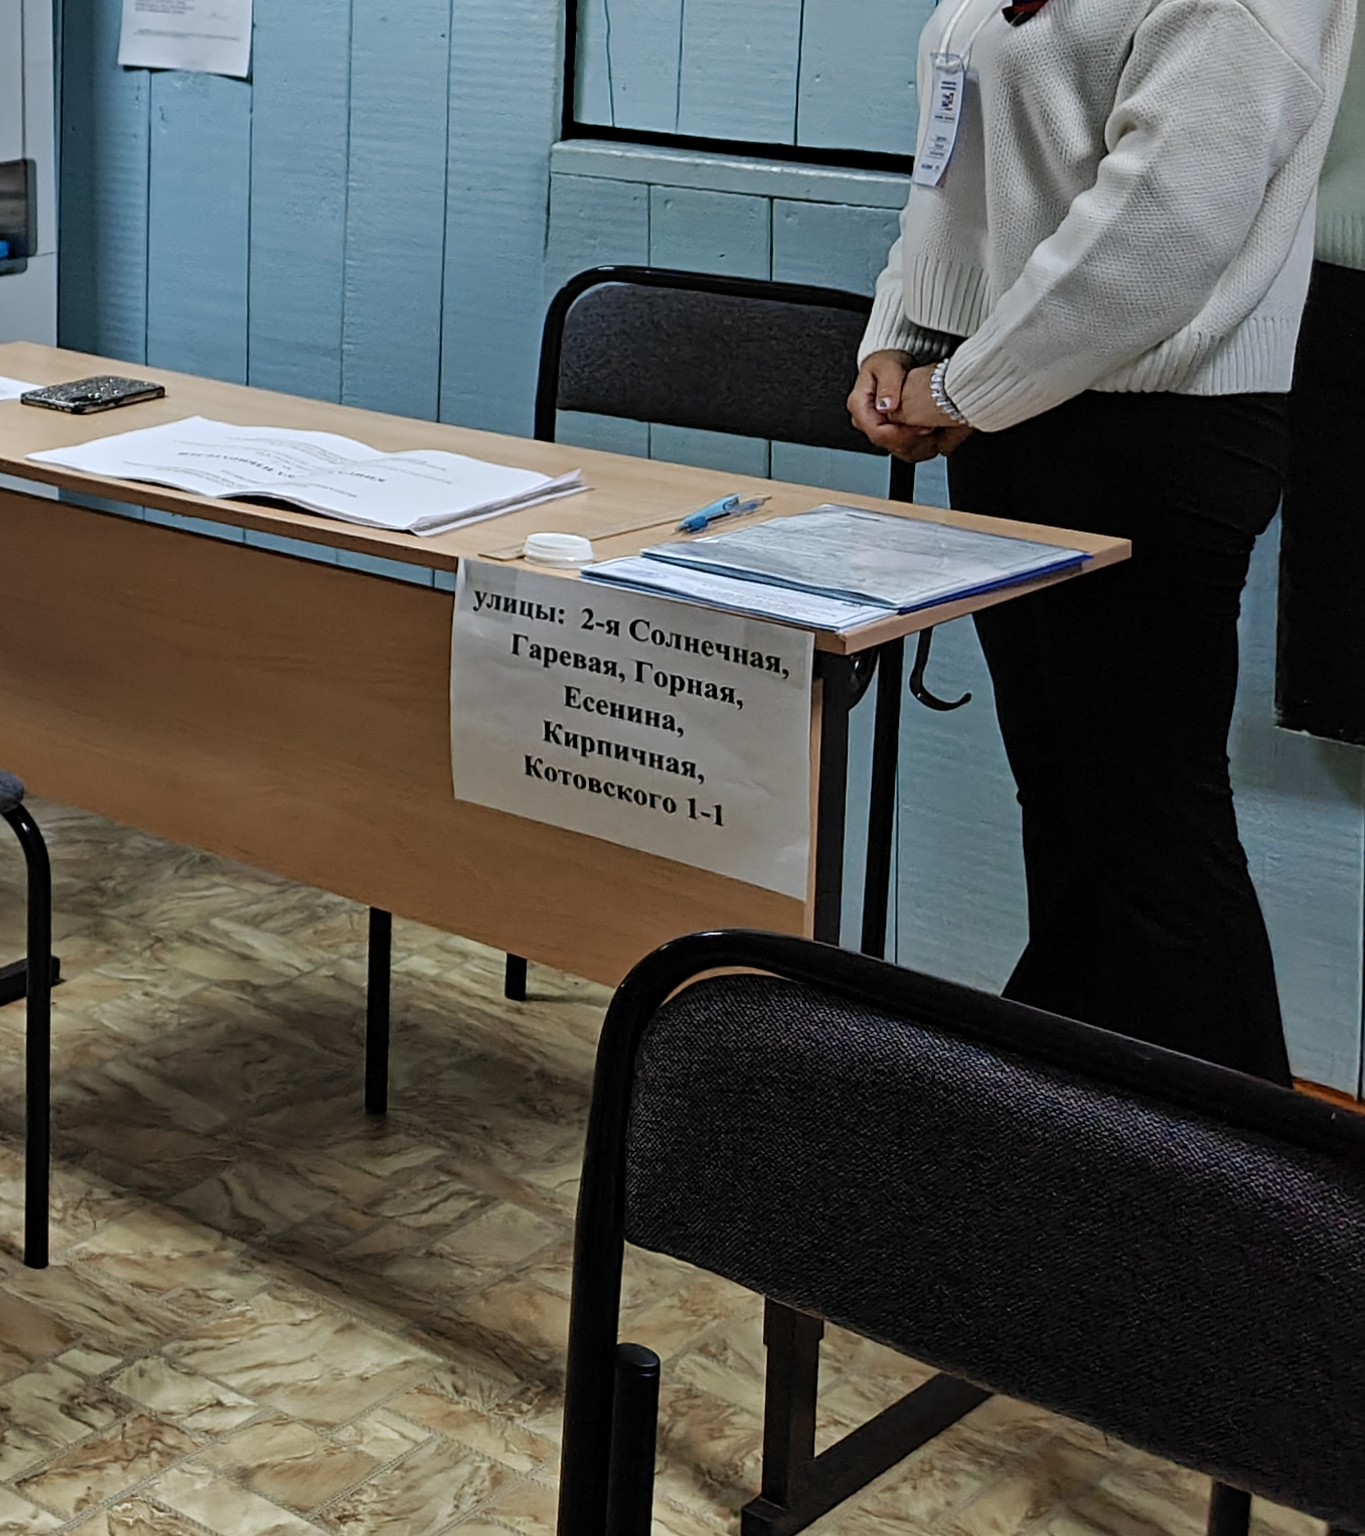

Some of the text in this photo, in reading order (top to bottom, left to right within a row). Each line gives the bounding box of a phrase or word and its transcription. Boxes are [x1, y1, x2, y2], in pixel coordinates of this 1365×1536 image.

[473, 588, 790, 680] улицы: 2-я Солнечная,
[511, 633, 745, 710] Гаревая, Горная,
[564, 684, 685, 738] Есенина,
[543, 719, 706, 784] Кирпичная,
[524, 754, 725, 827] Котовского 1-1
